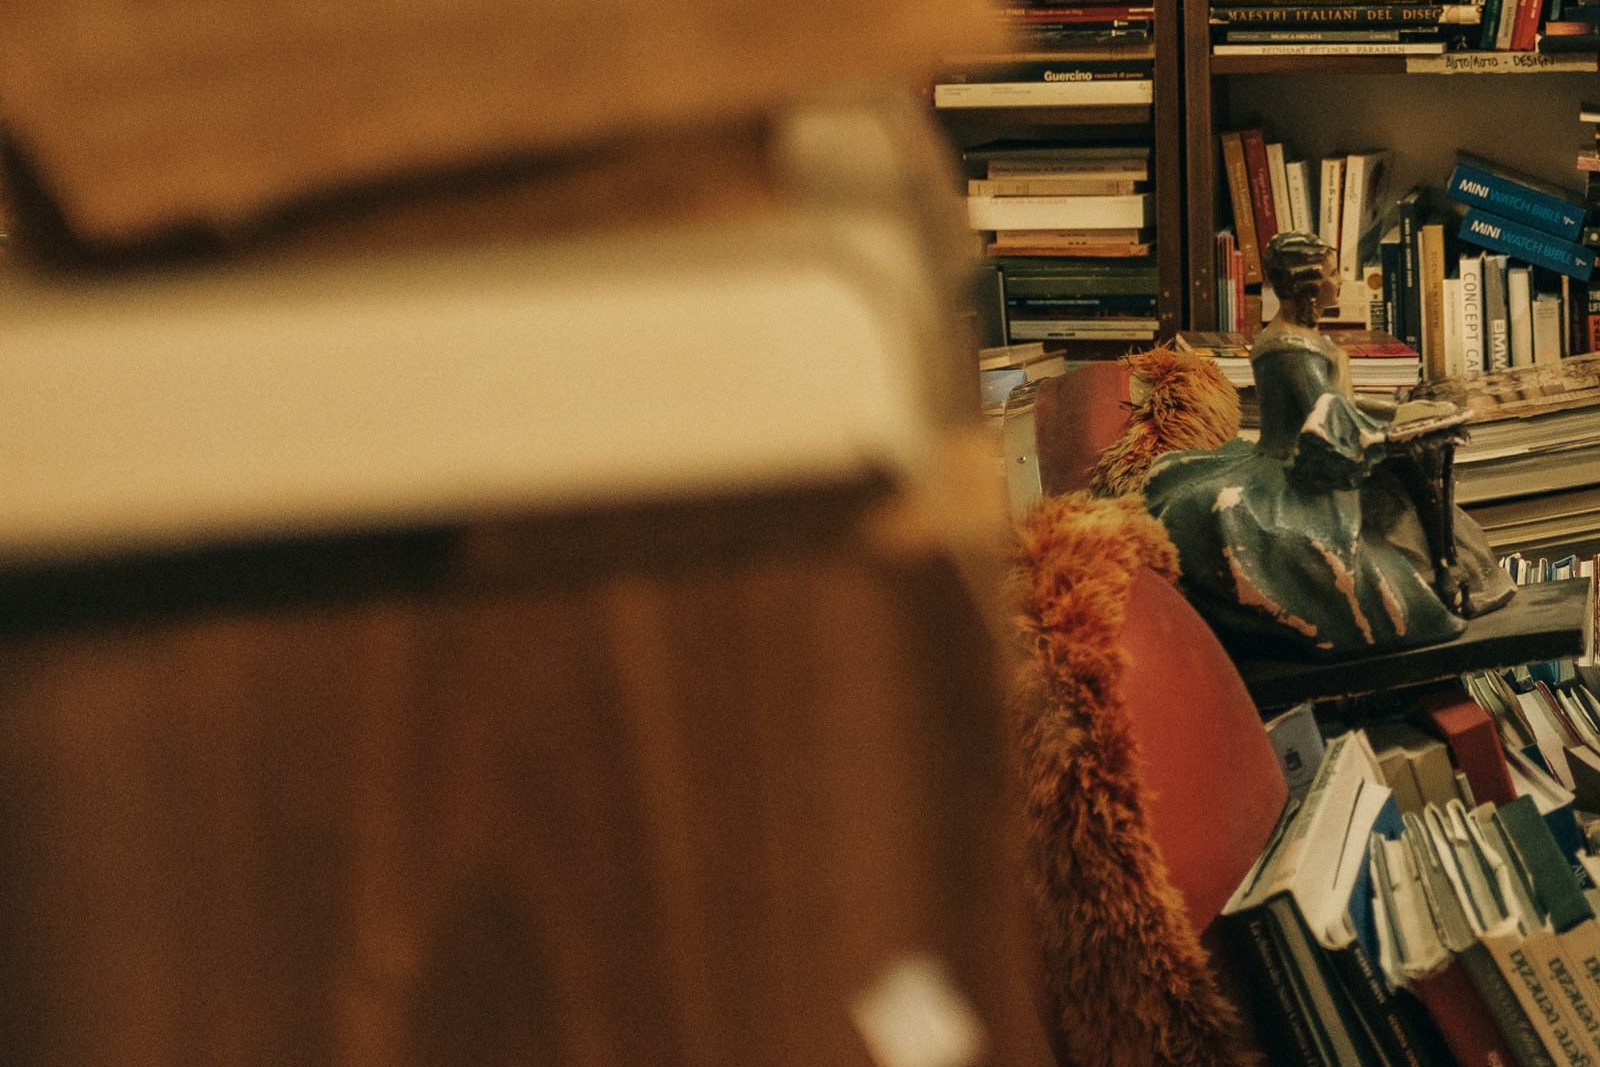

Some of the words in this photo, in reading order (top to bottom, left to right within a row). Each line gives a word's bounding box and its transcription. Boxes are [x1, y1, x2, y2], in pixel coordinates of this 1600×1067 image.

[1228, 10, 1287, 20] MAESTRI
[1296, 9, 1357, 20] ITALIANI
[1367, 9, 1392, 20] DEL
[1459, 179, 1490, 198] MINI
[1490, 189, 1532, 212] WATCH
[1532, 201, 1562, 224] BIBLE
[1470, 219, 1501, 240] MINI
[1500, 229, 1543, 254] WATCH
[1543, 242, 1572, 265] BIBLE
[1463, 272, 1478, 344] CONCEPT
[1493, 319, 1507, 372] BMW
